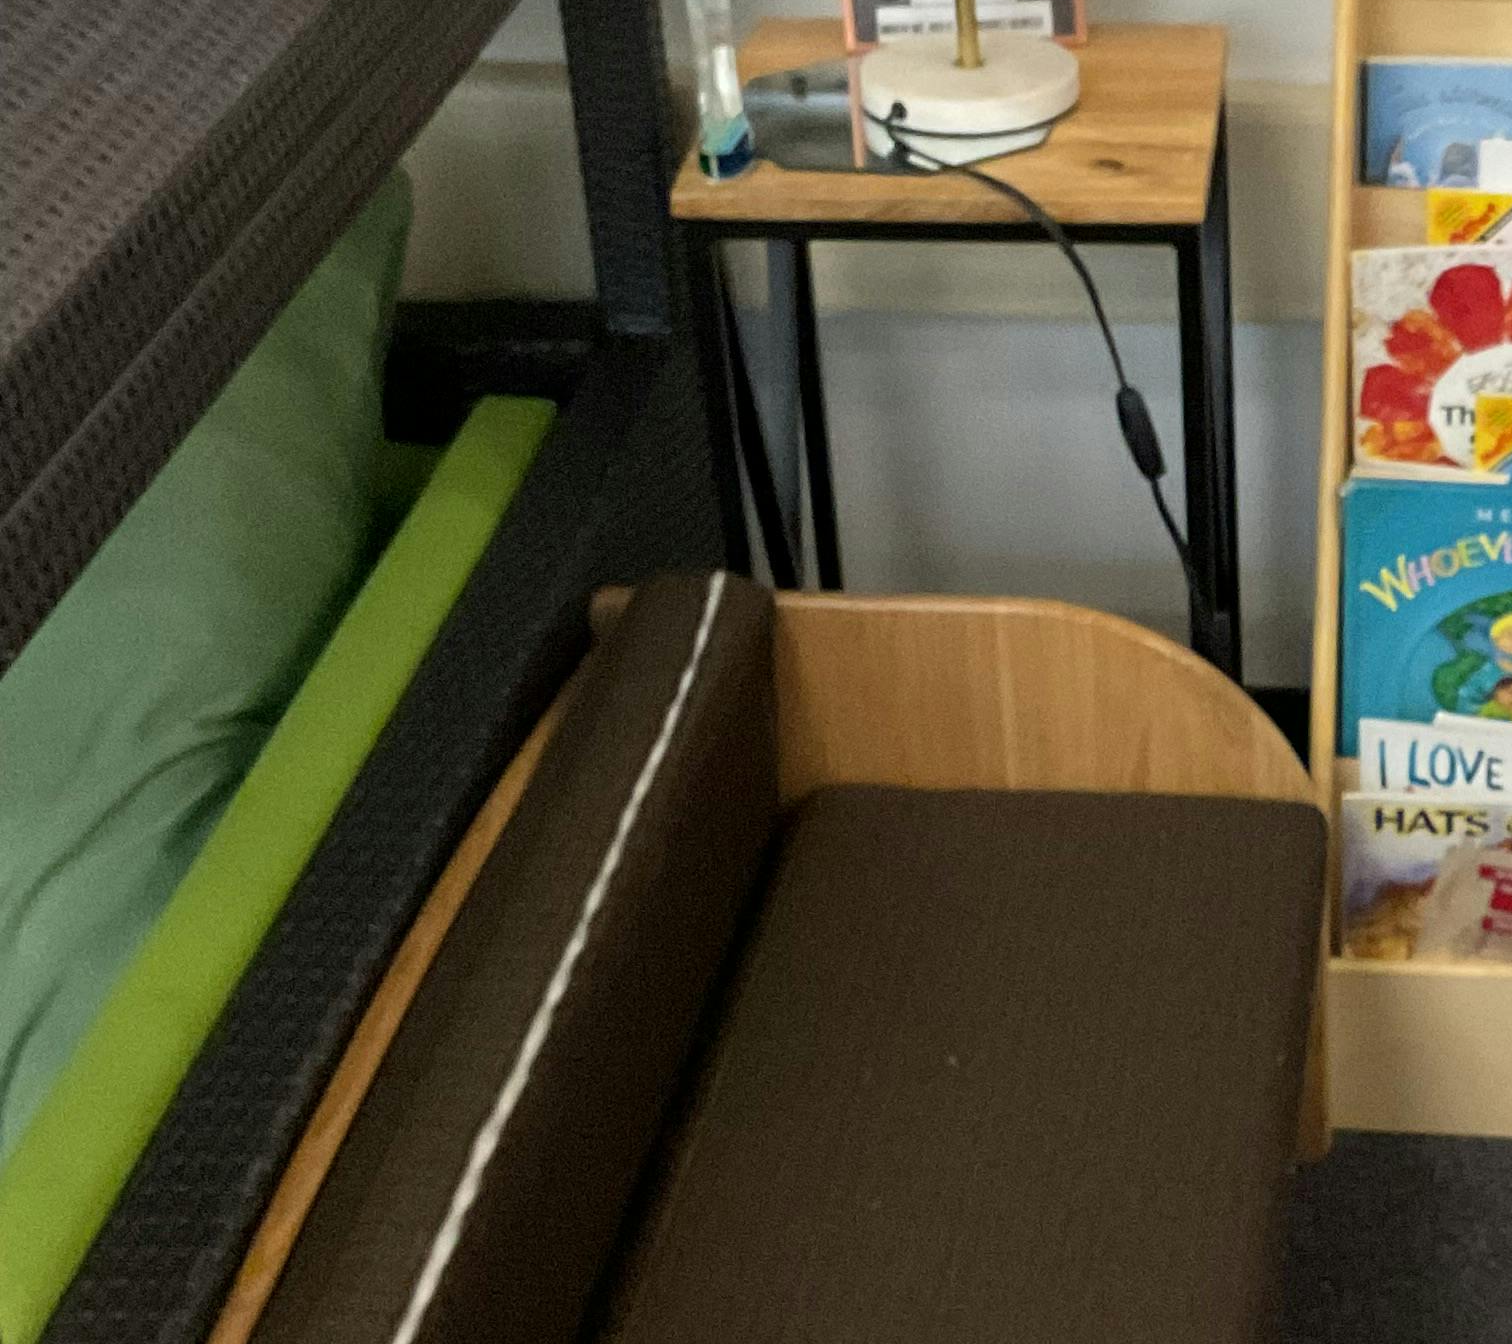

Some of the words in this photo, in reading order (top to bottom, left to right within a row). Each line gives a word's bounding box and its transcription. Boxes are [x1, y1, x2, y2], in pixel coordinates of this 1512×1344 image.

[1441, 405, 1476, 426] Th
[1379, 739, 1389, 789] I
[1407, 740, 1505, 791] LOVE
[1374, 806, 1490, 837] HATS
